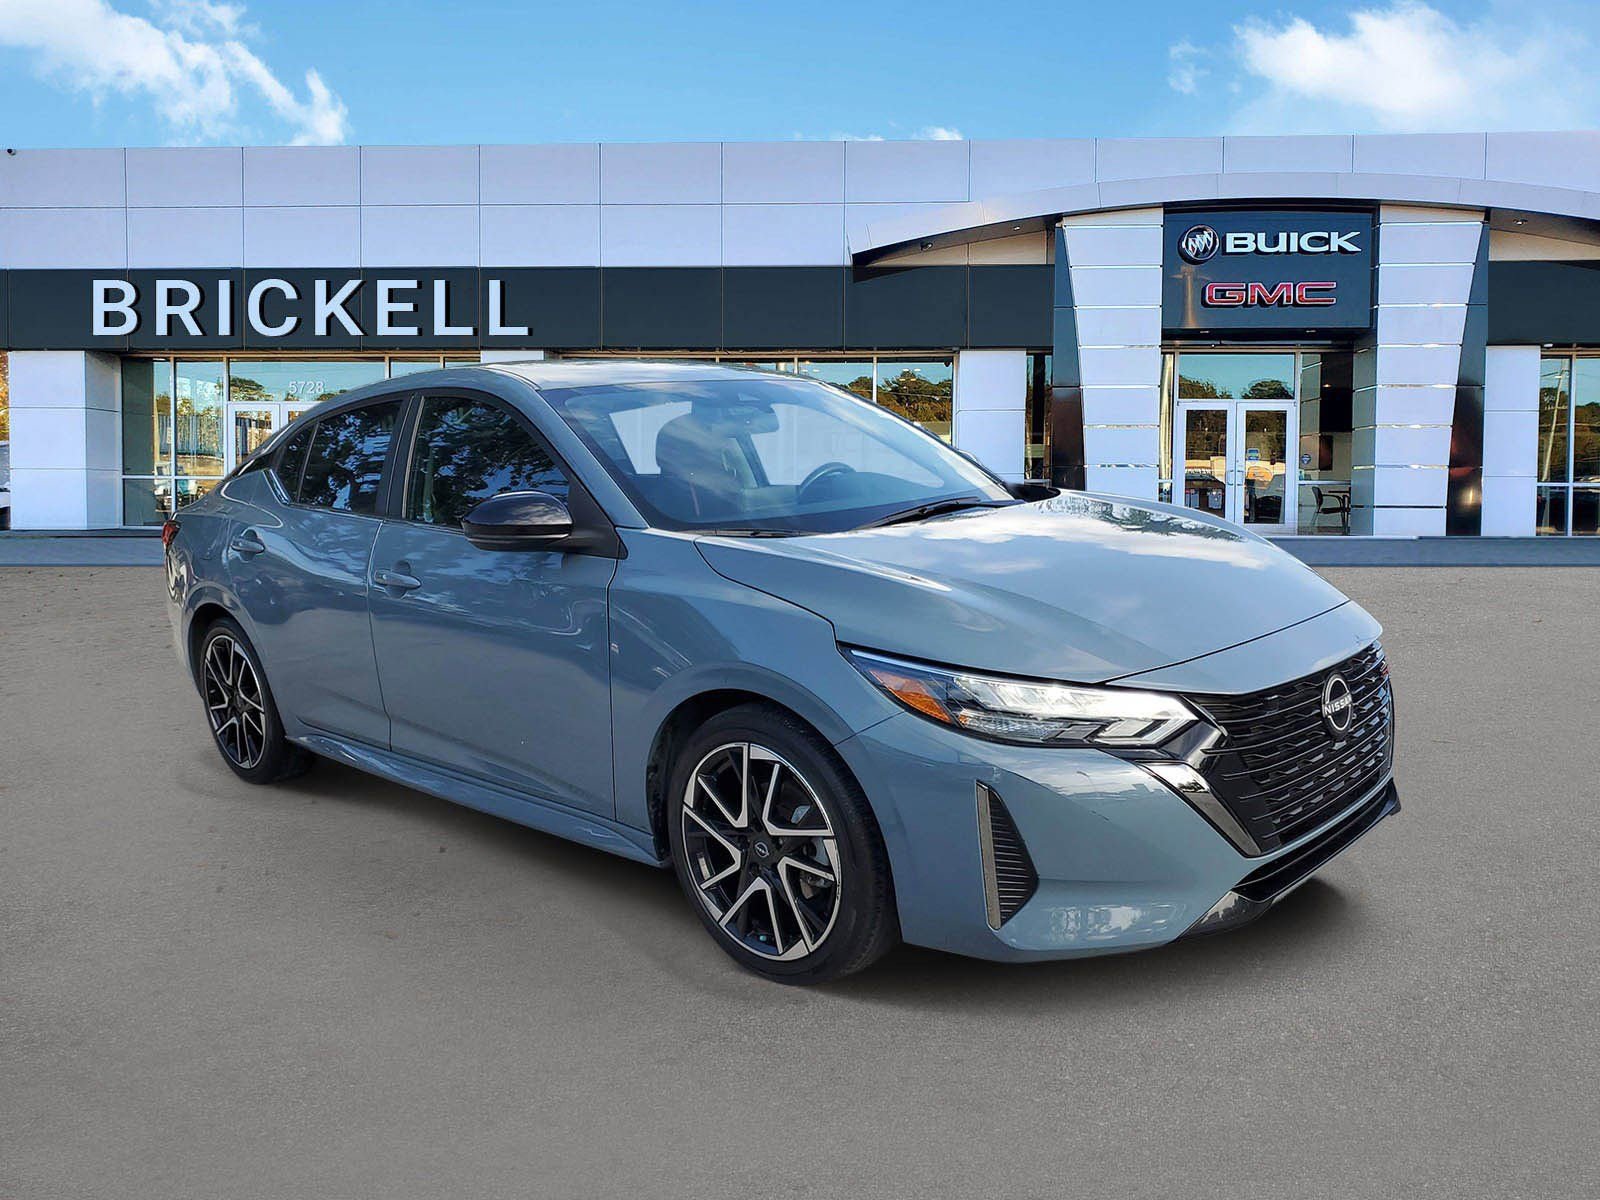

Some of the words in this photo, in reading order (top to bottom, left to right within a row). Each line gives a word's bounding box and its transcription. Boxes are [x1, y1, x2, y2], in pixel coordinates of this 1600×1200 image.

[1226, 232, 1361, 252] BUICK
[1206, 282, 1337, 304] GMC
[92, 279, 529, 337] BRICKELL
[288, 381, 324, 394] 5728
